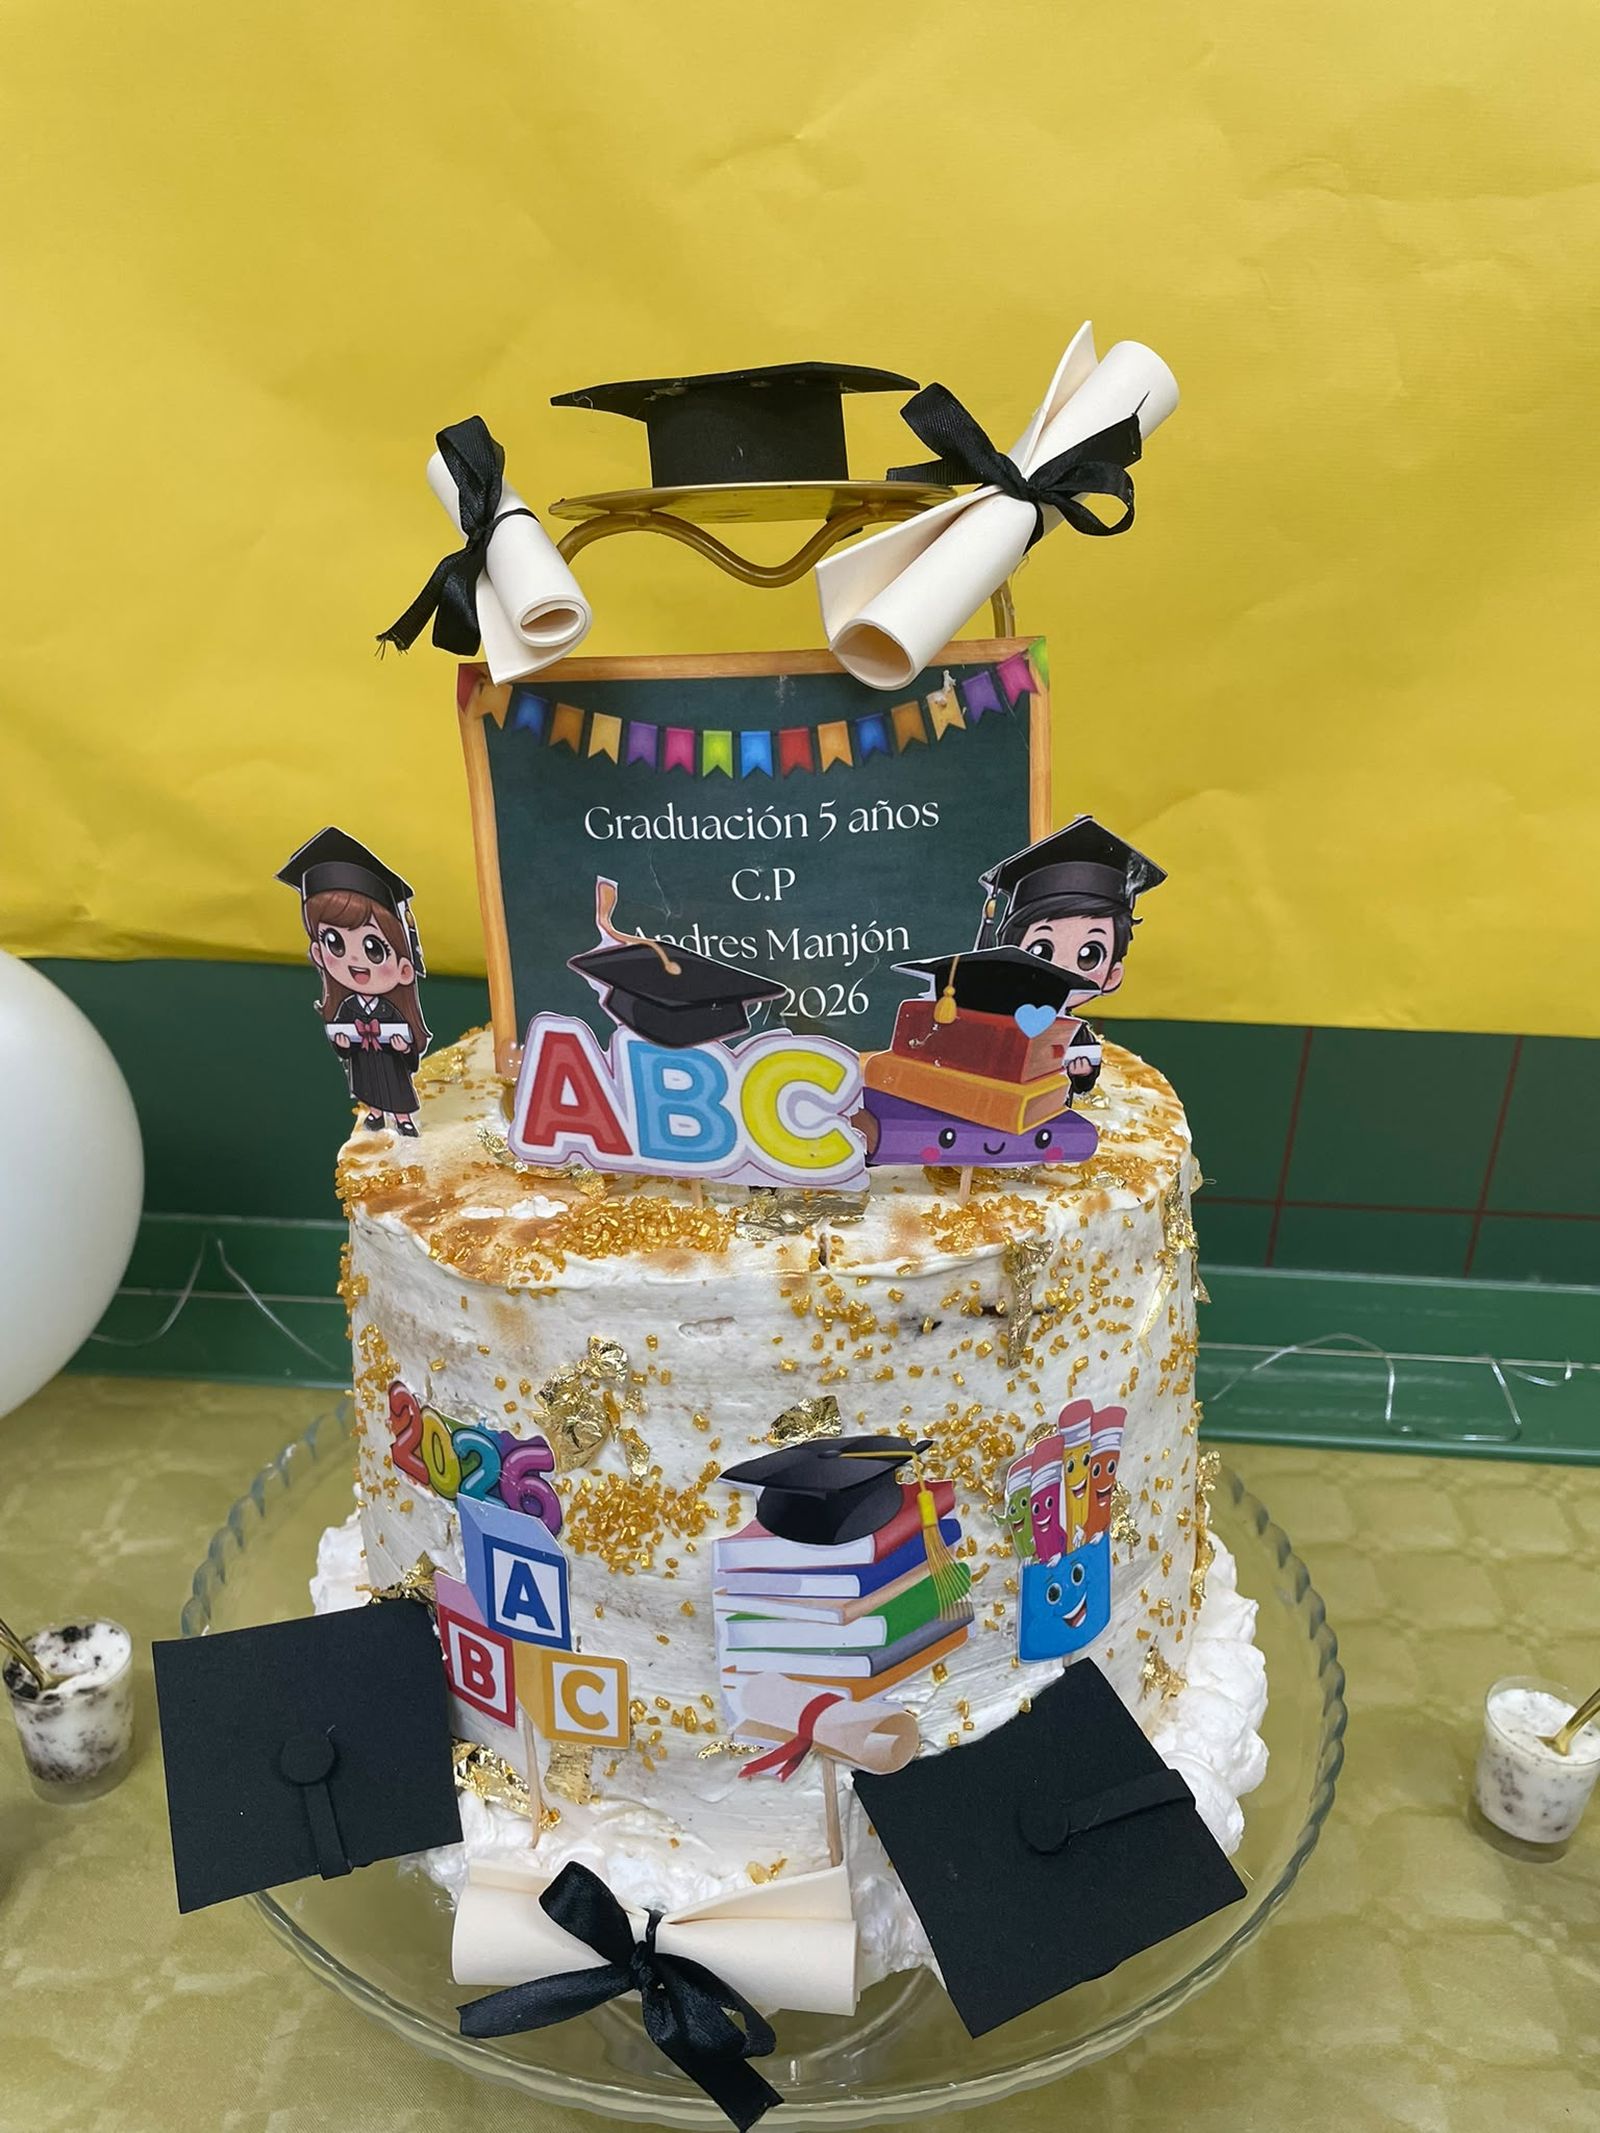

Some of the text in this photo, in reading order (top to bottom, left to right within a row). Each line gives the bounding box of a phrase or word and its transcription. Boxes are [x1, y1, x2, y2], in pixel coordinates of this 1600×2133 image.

[584, 799, 941, 842] Graduación 5 años
[731, 867, 796, 902] C.P
[765, 920, 910, 967] Manjón
[521, 1030, 856, 1170] ABC
[388, 1380, 563, 1536] 2026
[501, 1560, 555, 1631] A
[459, 1632, 611, 1731] B C
